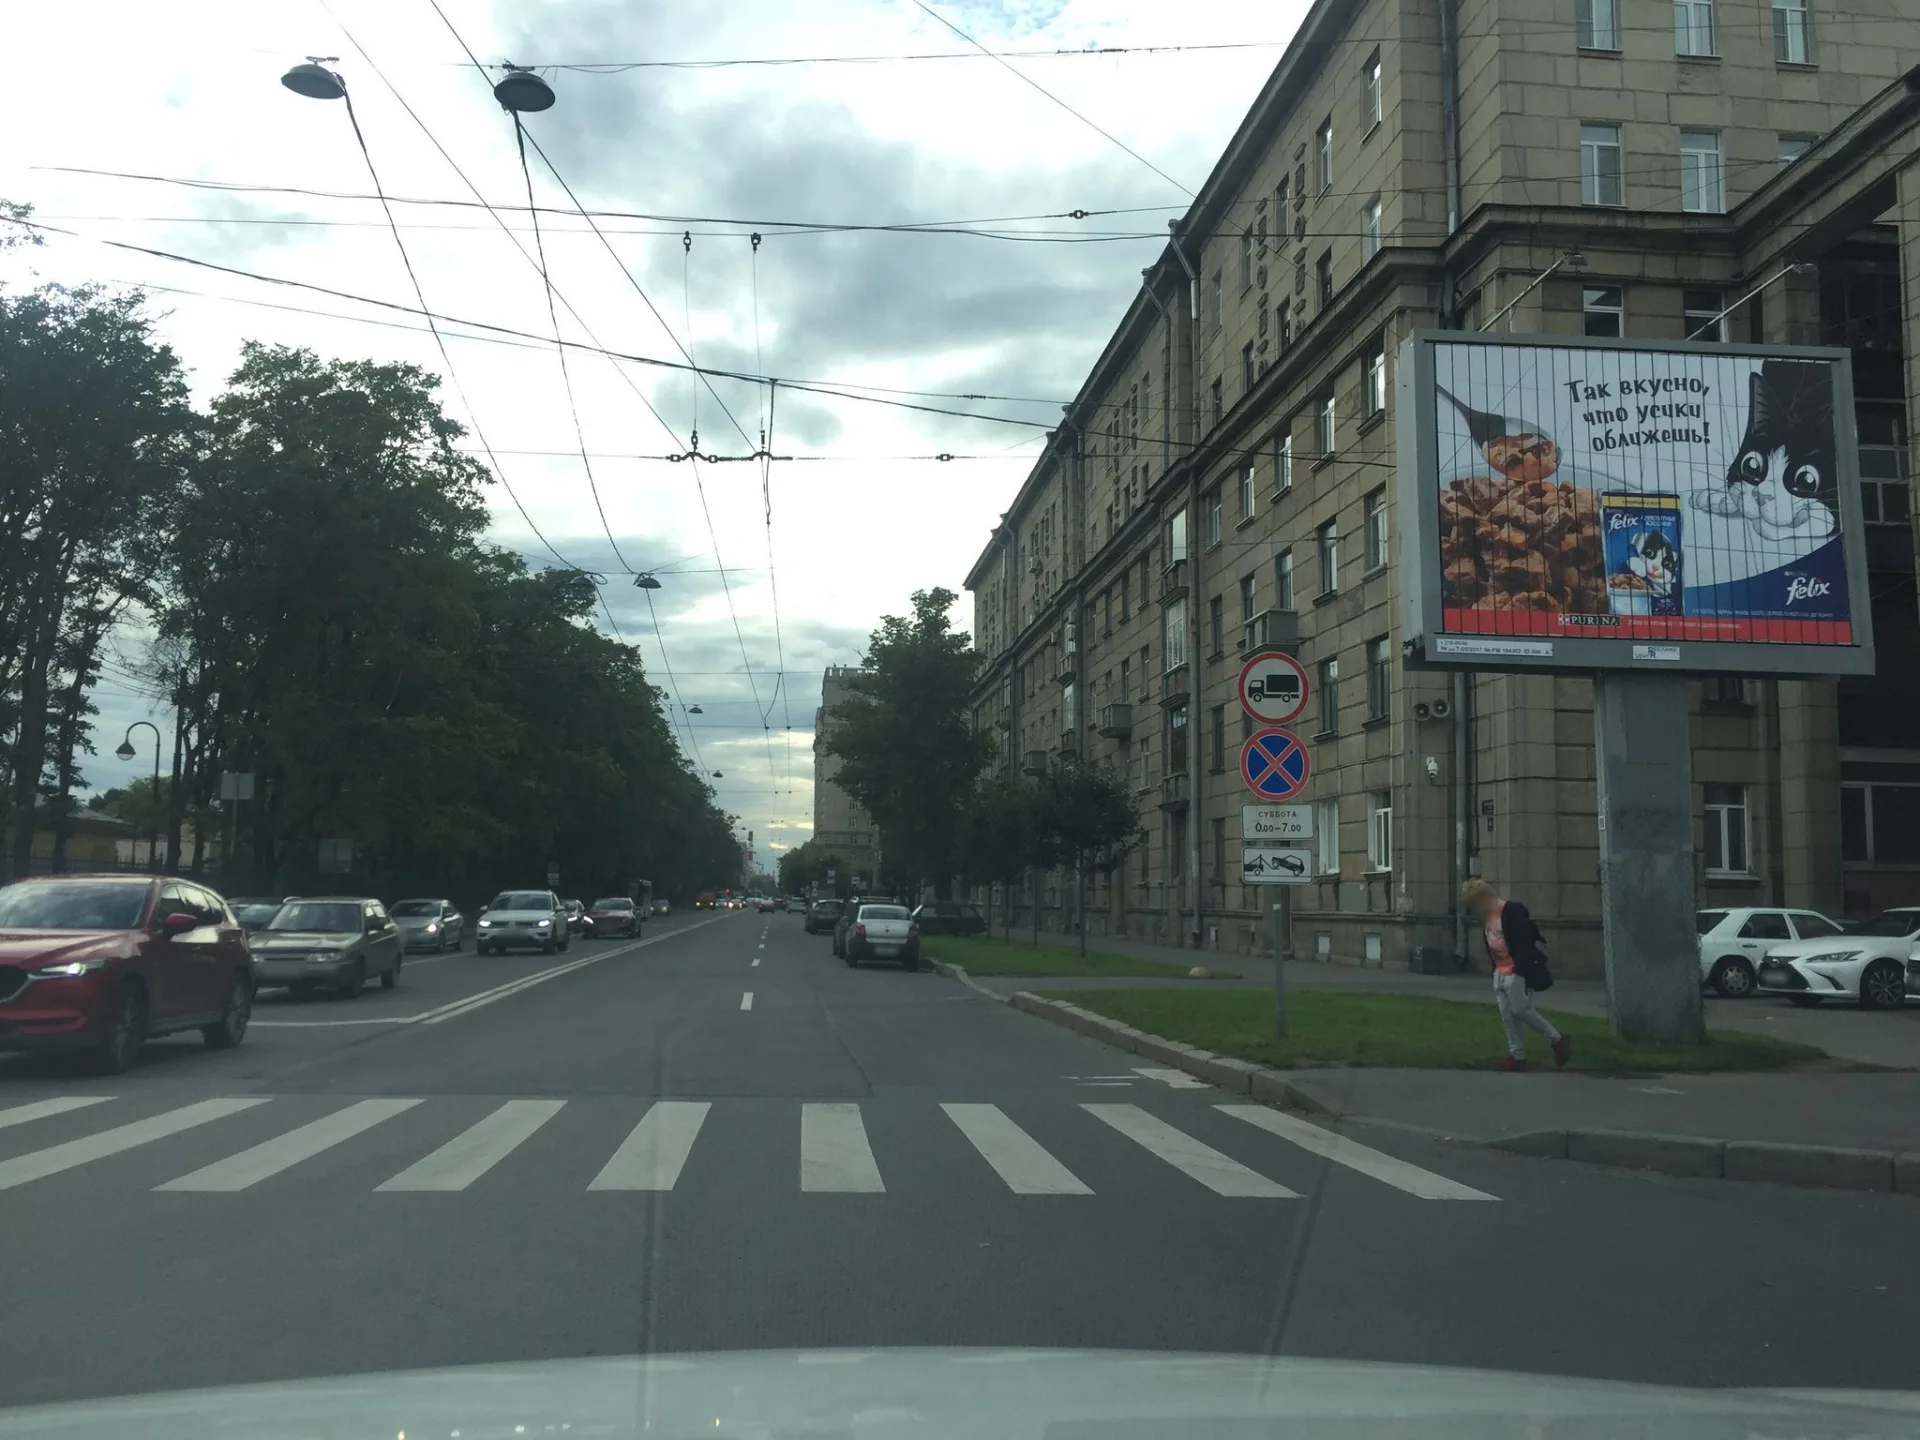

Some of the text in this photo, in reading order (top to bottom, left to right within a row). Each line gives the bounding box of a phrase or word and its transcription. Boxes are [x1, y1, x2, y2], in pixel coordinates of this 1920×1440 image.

[1563, 377, 1710, 403] Так вкусно,
[1583, 403, 1701, 426] что усики
[1592, 421, 1711, 451] оближешь!
[1608, 513, 1639, 534] felix
[1786, 577, 1830, 606] felix
[1571, 616, 1619, 626] PURINA
[1258, 810, 1298, 818] СУББОТА
